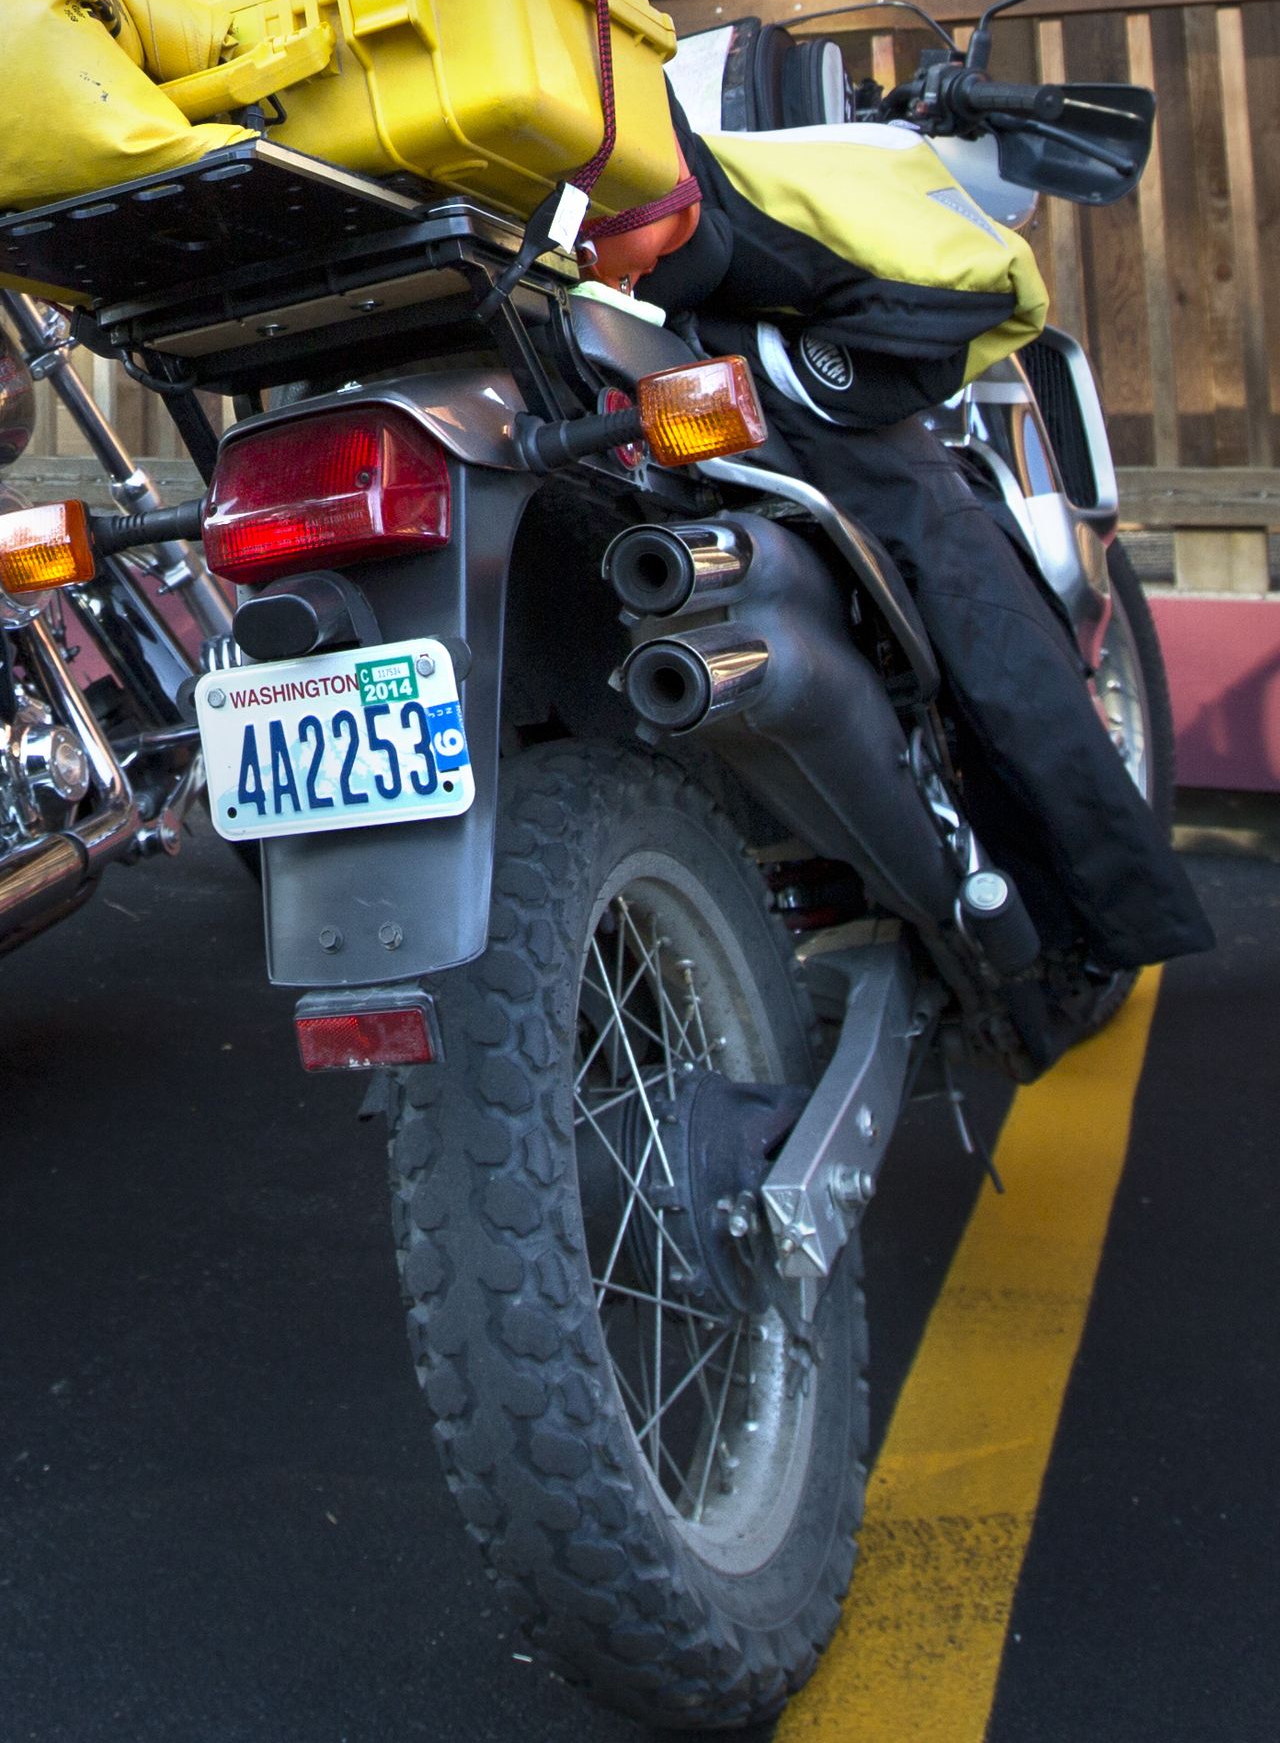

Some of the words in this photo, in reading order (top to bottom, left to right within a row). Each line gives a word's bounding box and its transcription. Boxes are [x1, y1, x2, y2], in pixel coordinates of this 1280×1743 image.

[229, 673, 360, 709] WASHINGTON
[364, 679, 413, 702] 2014
[238, 701, 438, 816] 4A2253
